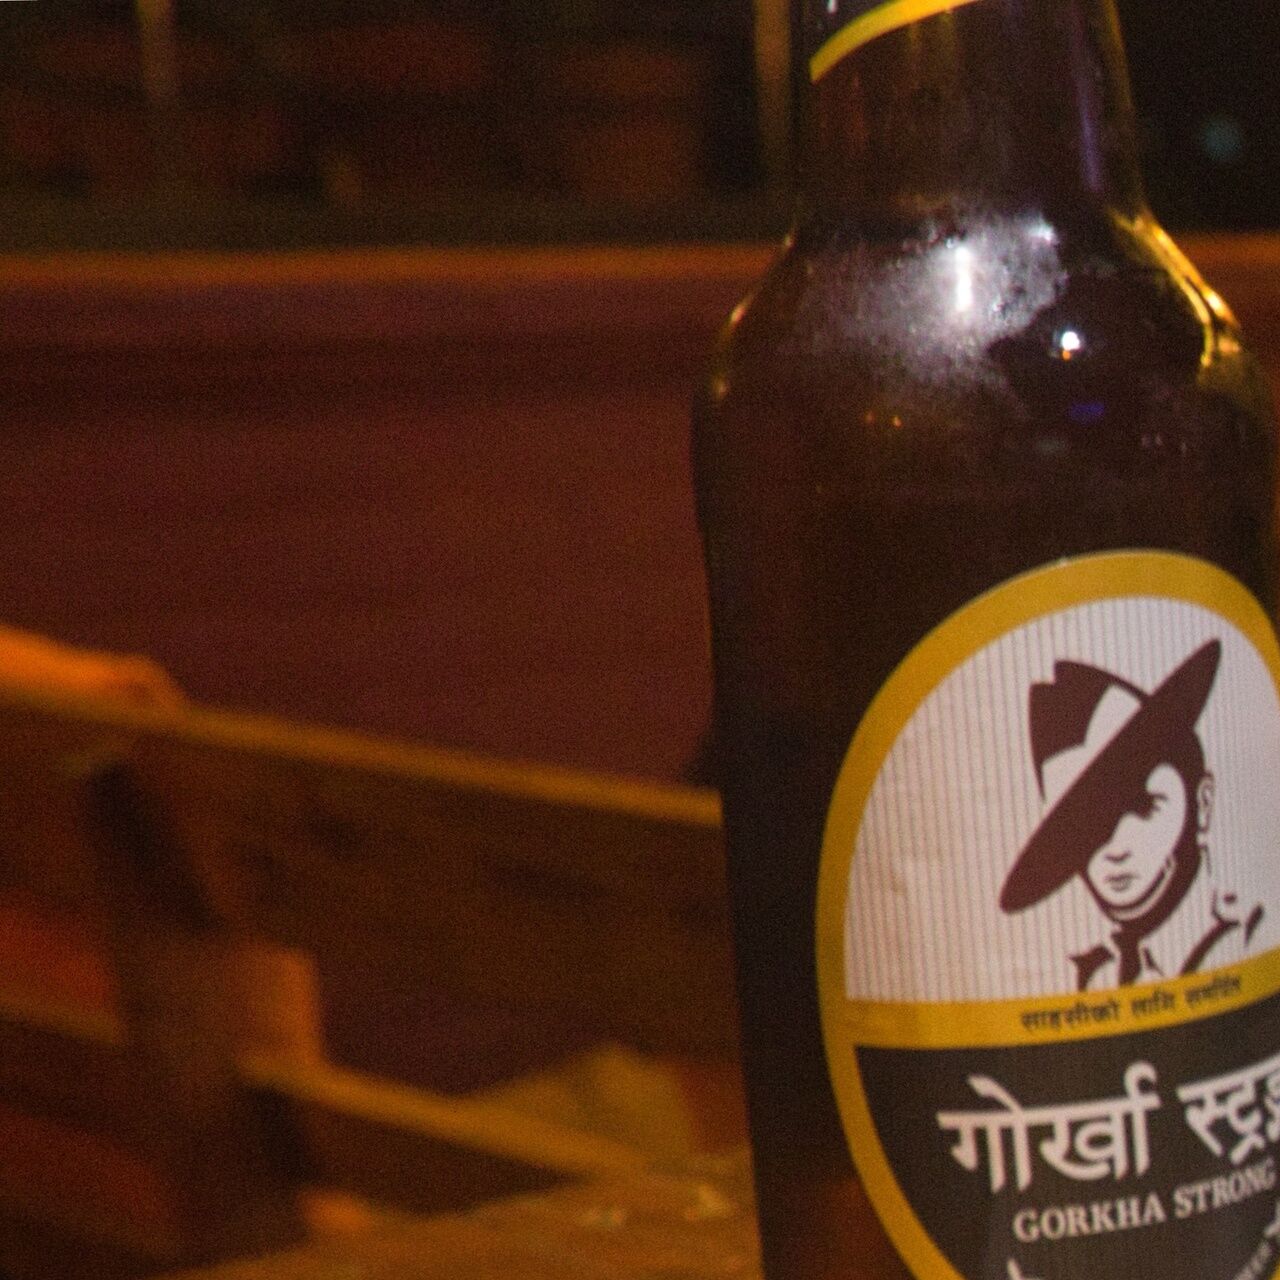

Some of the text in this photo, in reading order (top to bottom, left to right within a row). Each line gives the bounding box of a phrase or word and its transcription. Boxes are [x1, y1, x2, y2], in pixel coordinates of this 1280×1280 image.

[937, 1061, 1160, 1194] गोर्खा
[1013, 1158, 1275, 1243] GORKHA STRONG
